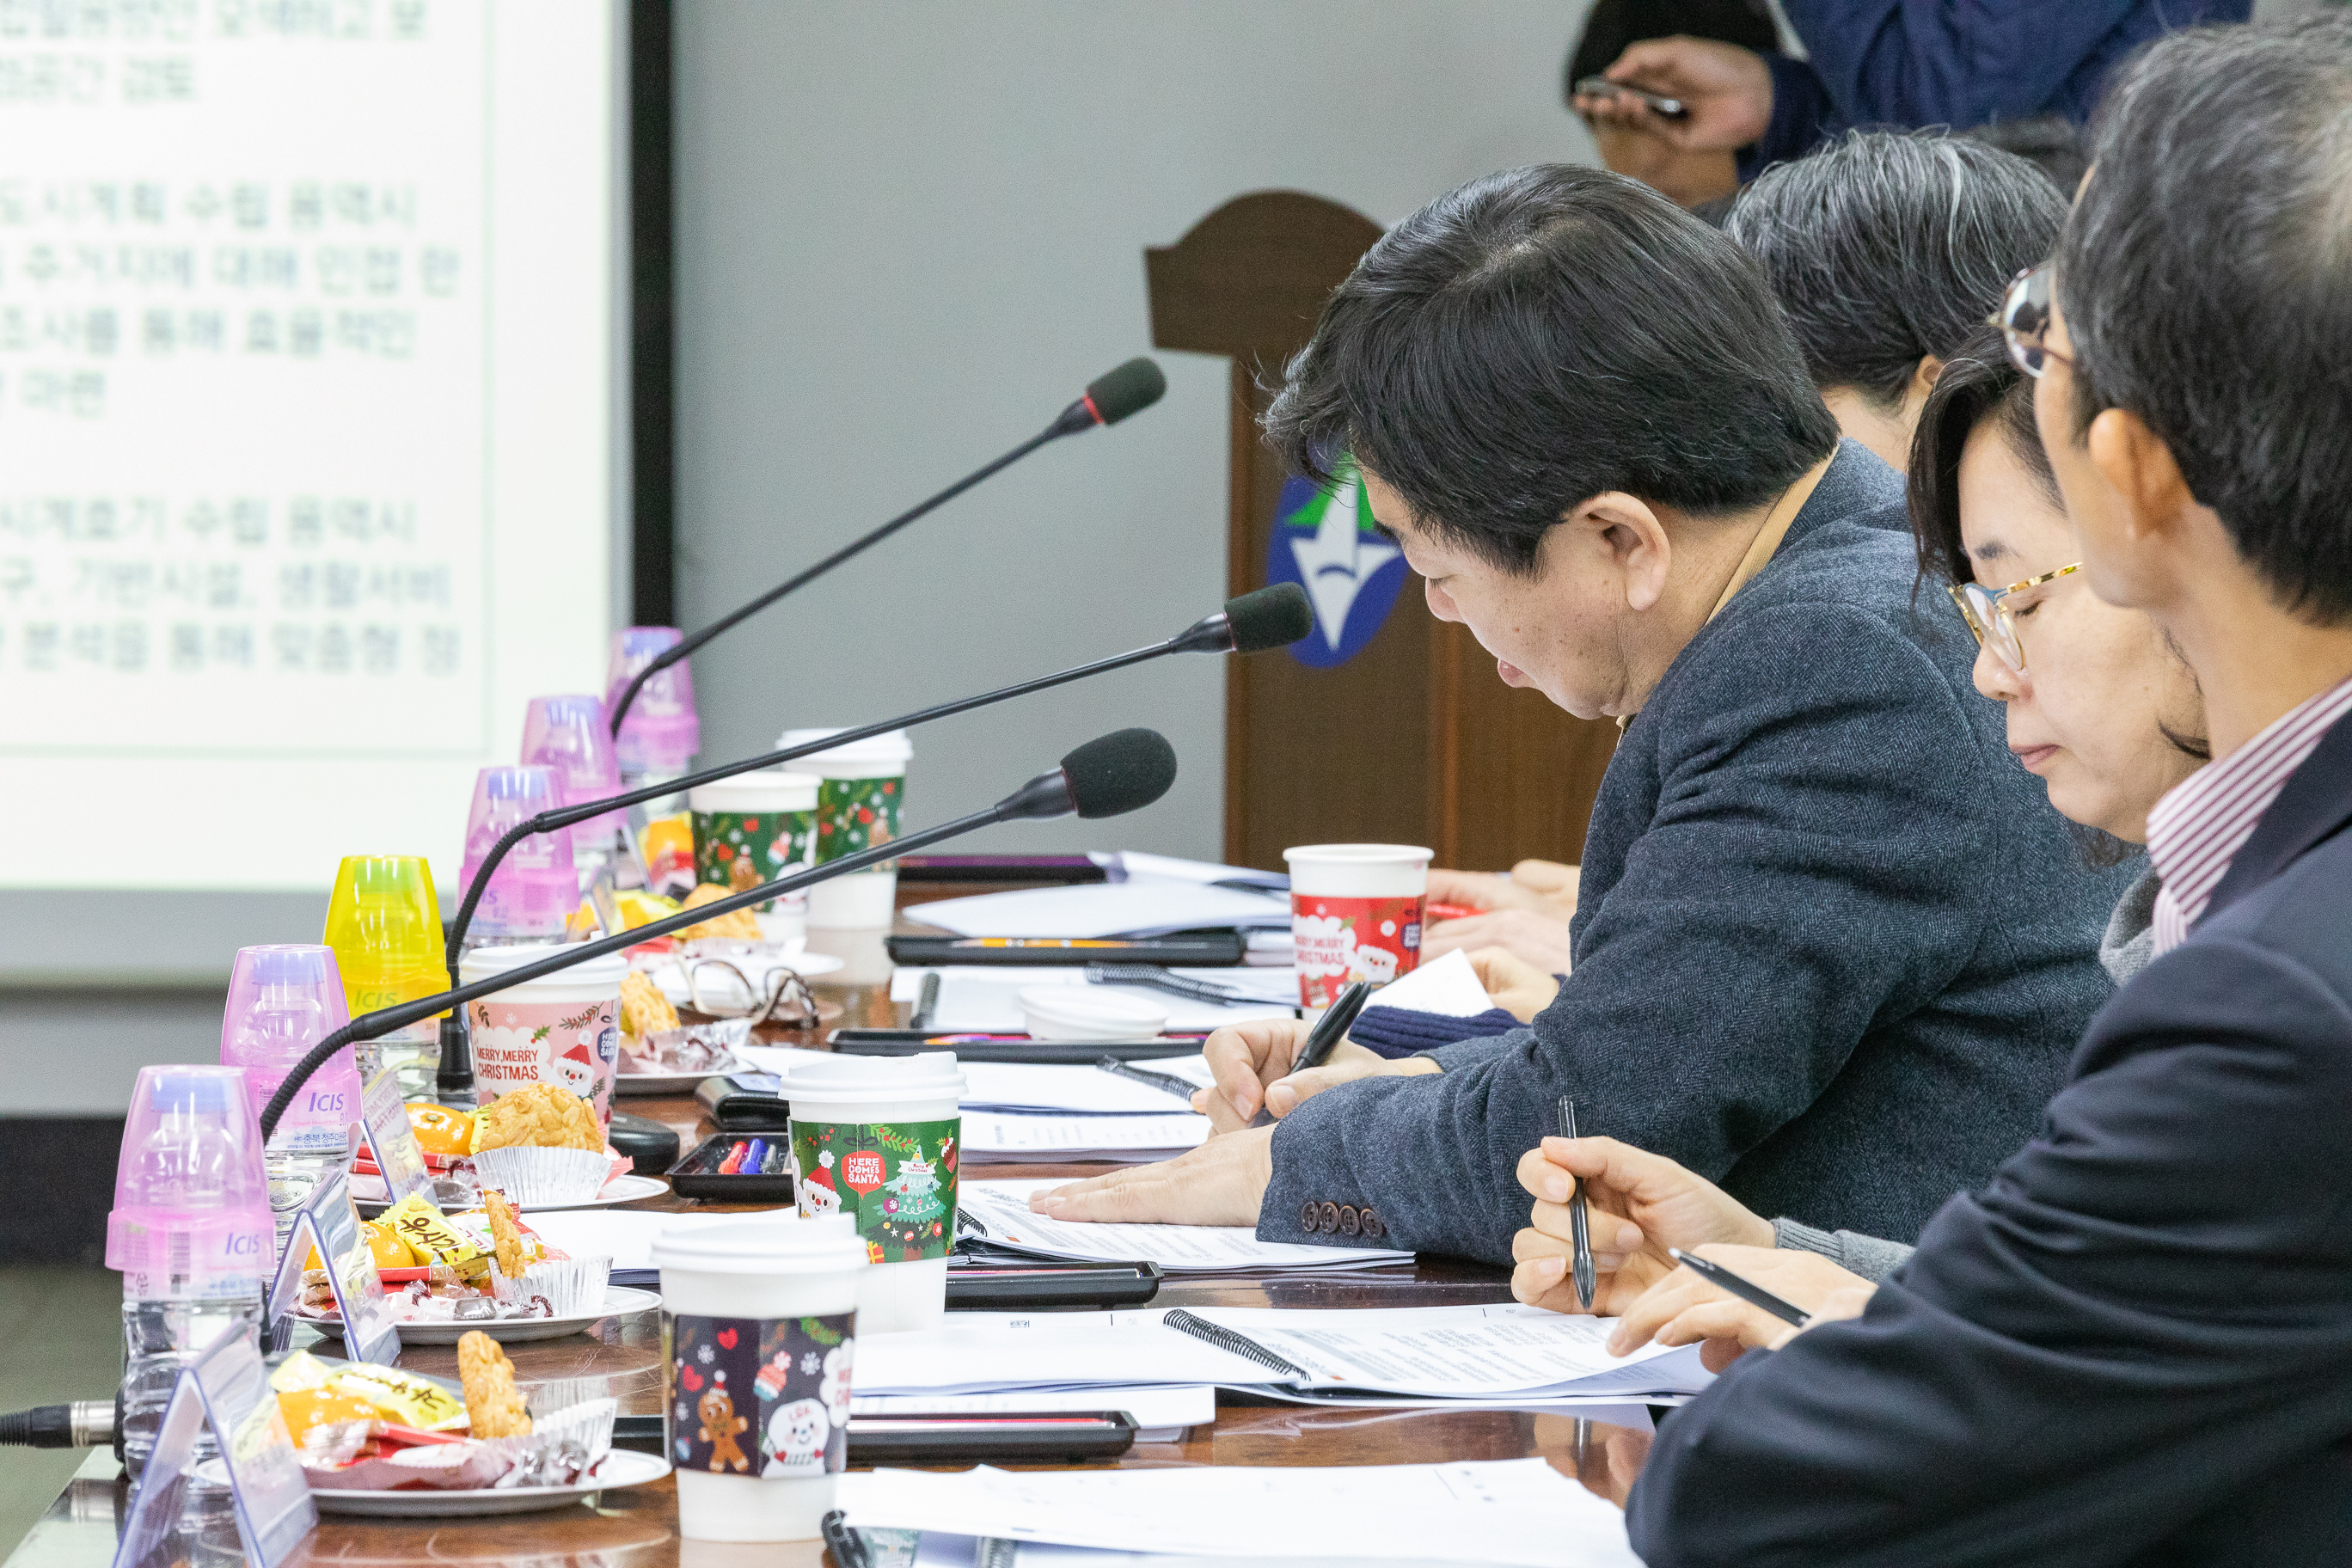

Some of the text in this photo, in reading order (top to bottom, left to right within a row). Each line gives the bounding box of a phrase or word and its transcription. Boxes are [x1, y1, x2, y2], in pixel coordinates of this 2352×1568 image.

[478, 1063, 539, 1081] CHRISTMAS
[309, 1092, 345, 1112] ICIS
[848, 1157, 879, 1167] HERE
[848, 1165, 880, 1174] COMES
[848, 1173, 881, 1185] SANTA
